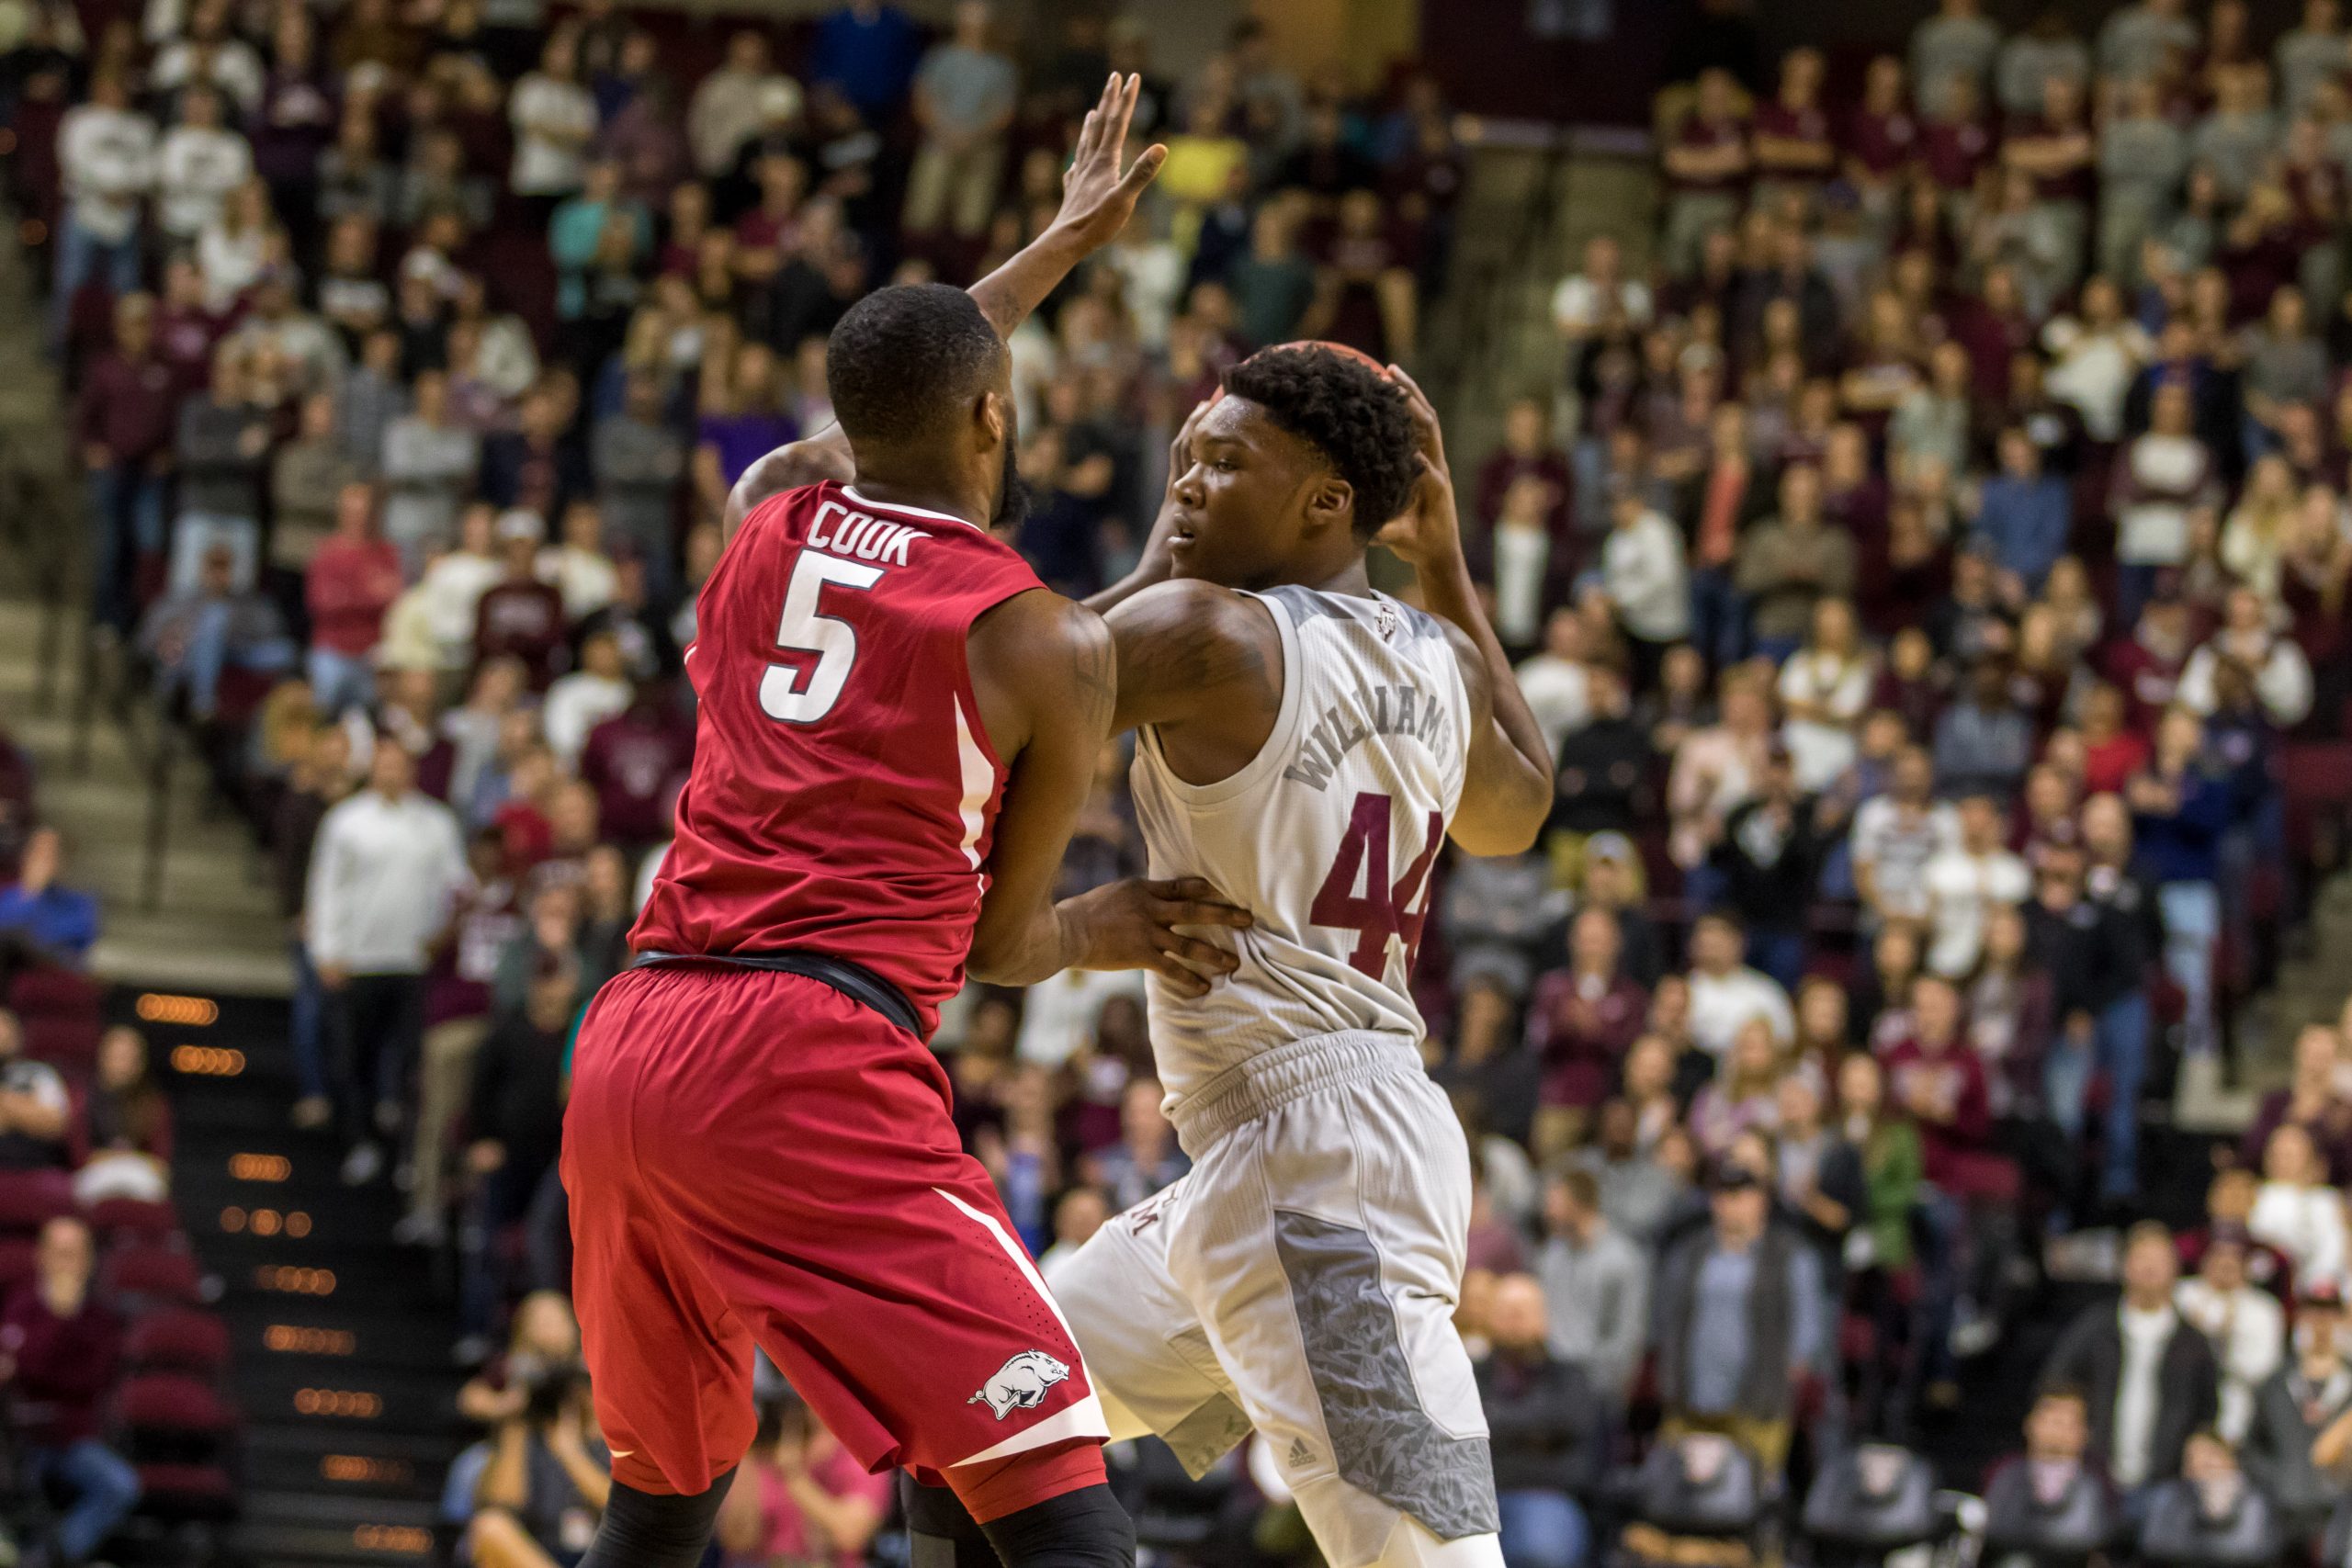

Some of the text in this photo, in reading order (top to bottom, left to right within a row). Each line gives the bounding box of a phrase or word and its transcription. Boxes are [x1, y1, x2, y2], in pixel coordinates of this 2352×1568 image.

[807, 501, 933, 566] COOK
[758, 547, 888, 725] 5
[1309, 791, 1444, 988] 44
